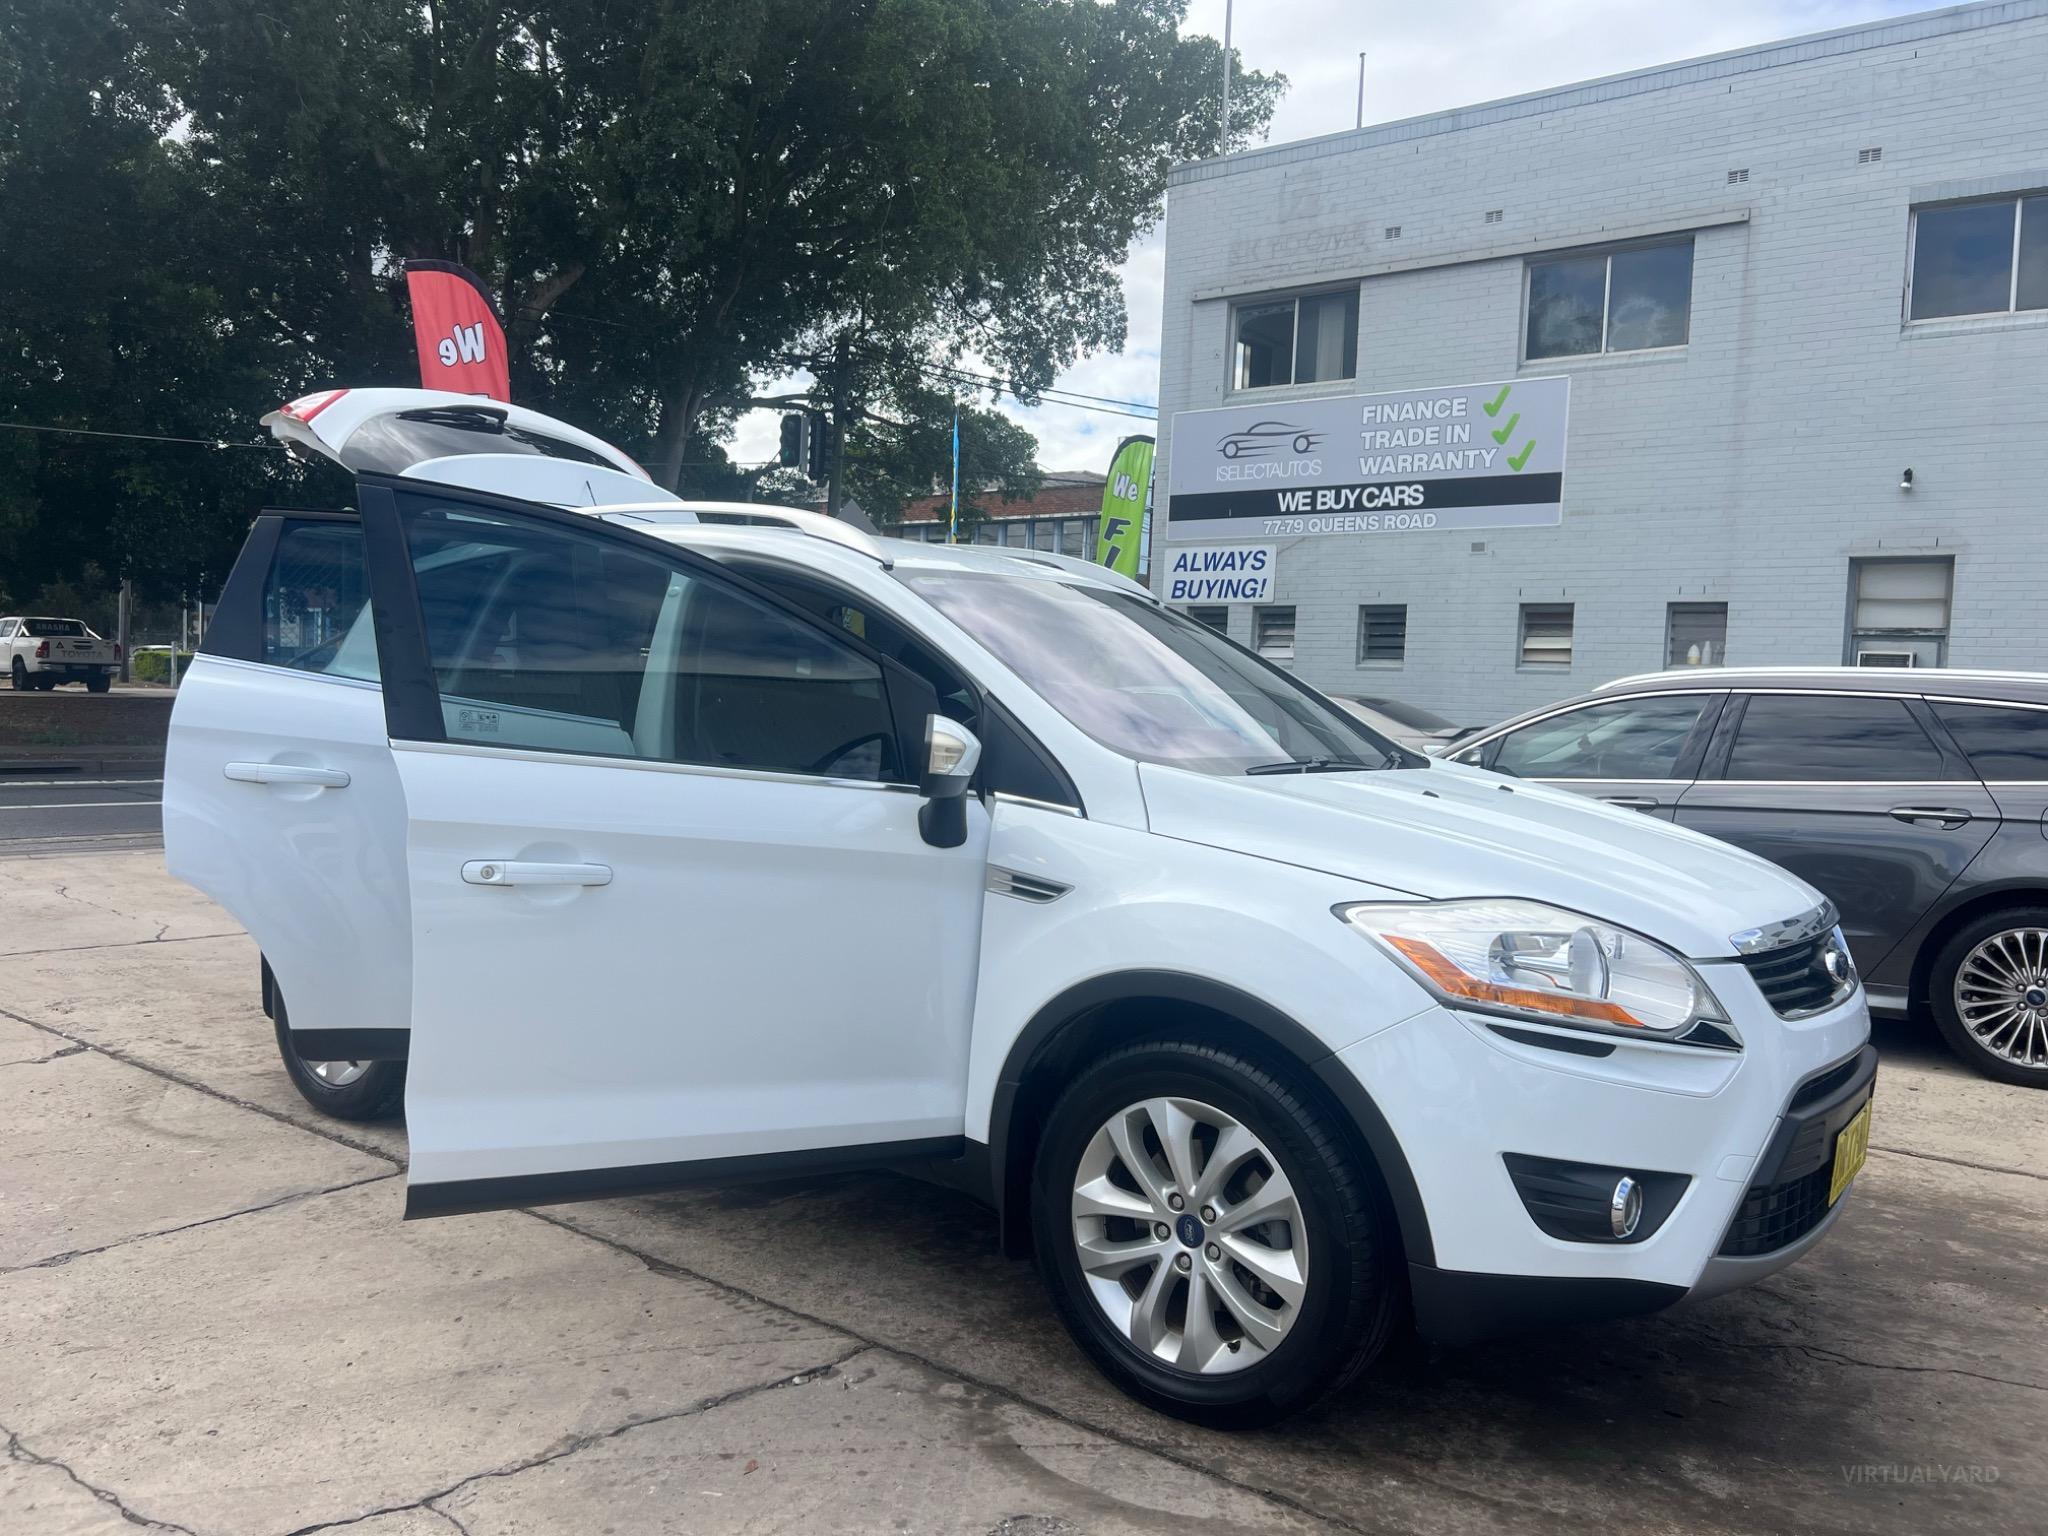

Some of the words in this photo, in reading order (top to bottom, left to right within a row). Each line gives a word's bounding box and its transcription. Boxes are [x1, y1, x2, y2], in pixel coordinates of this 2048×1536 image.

[1362, 397, 1468, 425] FINANCE
[1360, 426, 1440, 450] TRADE
[1445, 423, 1471, 444] IN
[1216, 459, 1322, 481] ISELECTAUTOS
[1359, 447, 1499, 476] WARRANTY
[1113, 472, 1139, 503] We
[1277, 490, 1312, 512] WE
[1316, 487, 1361, 510] BUY
[1361, 484, 1425, 508] CARS
[1263, 518, 1304, 535] 77-79
[1308, 515, 1380, 533] QUEENS
[1384, 513, 1438, 530] ROAD
[1173, 550, 1268, 572] ALWAYS
[1170, 578, 1268, 599] BUYING!
[61, 650, 104, 659] TOYOTA
